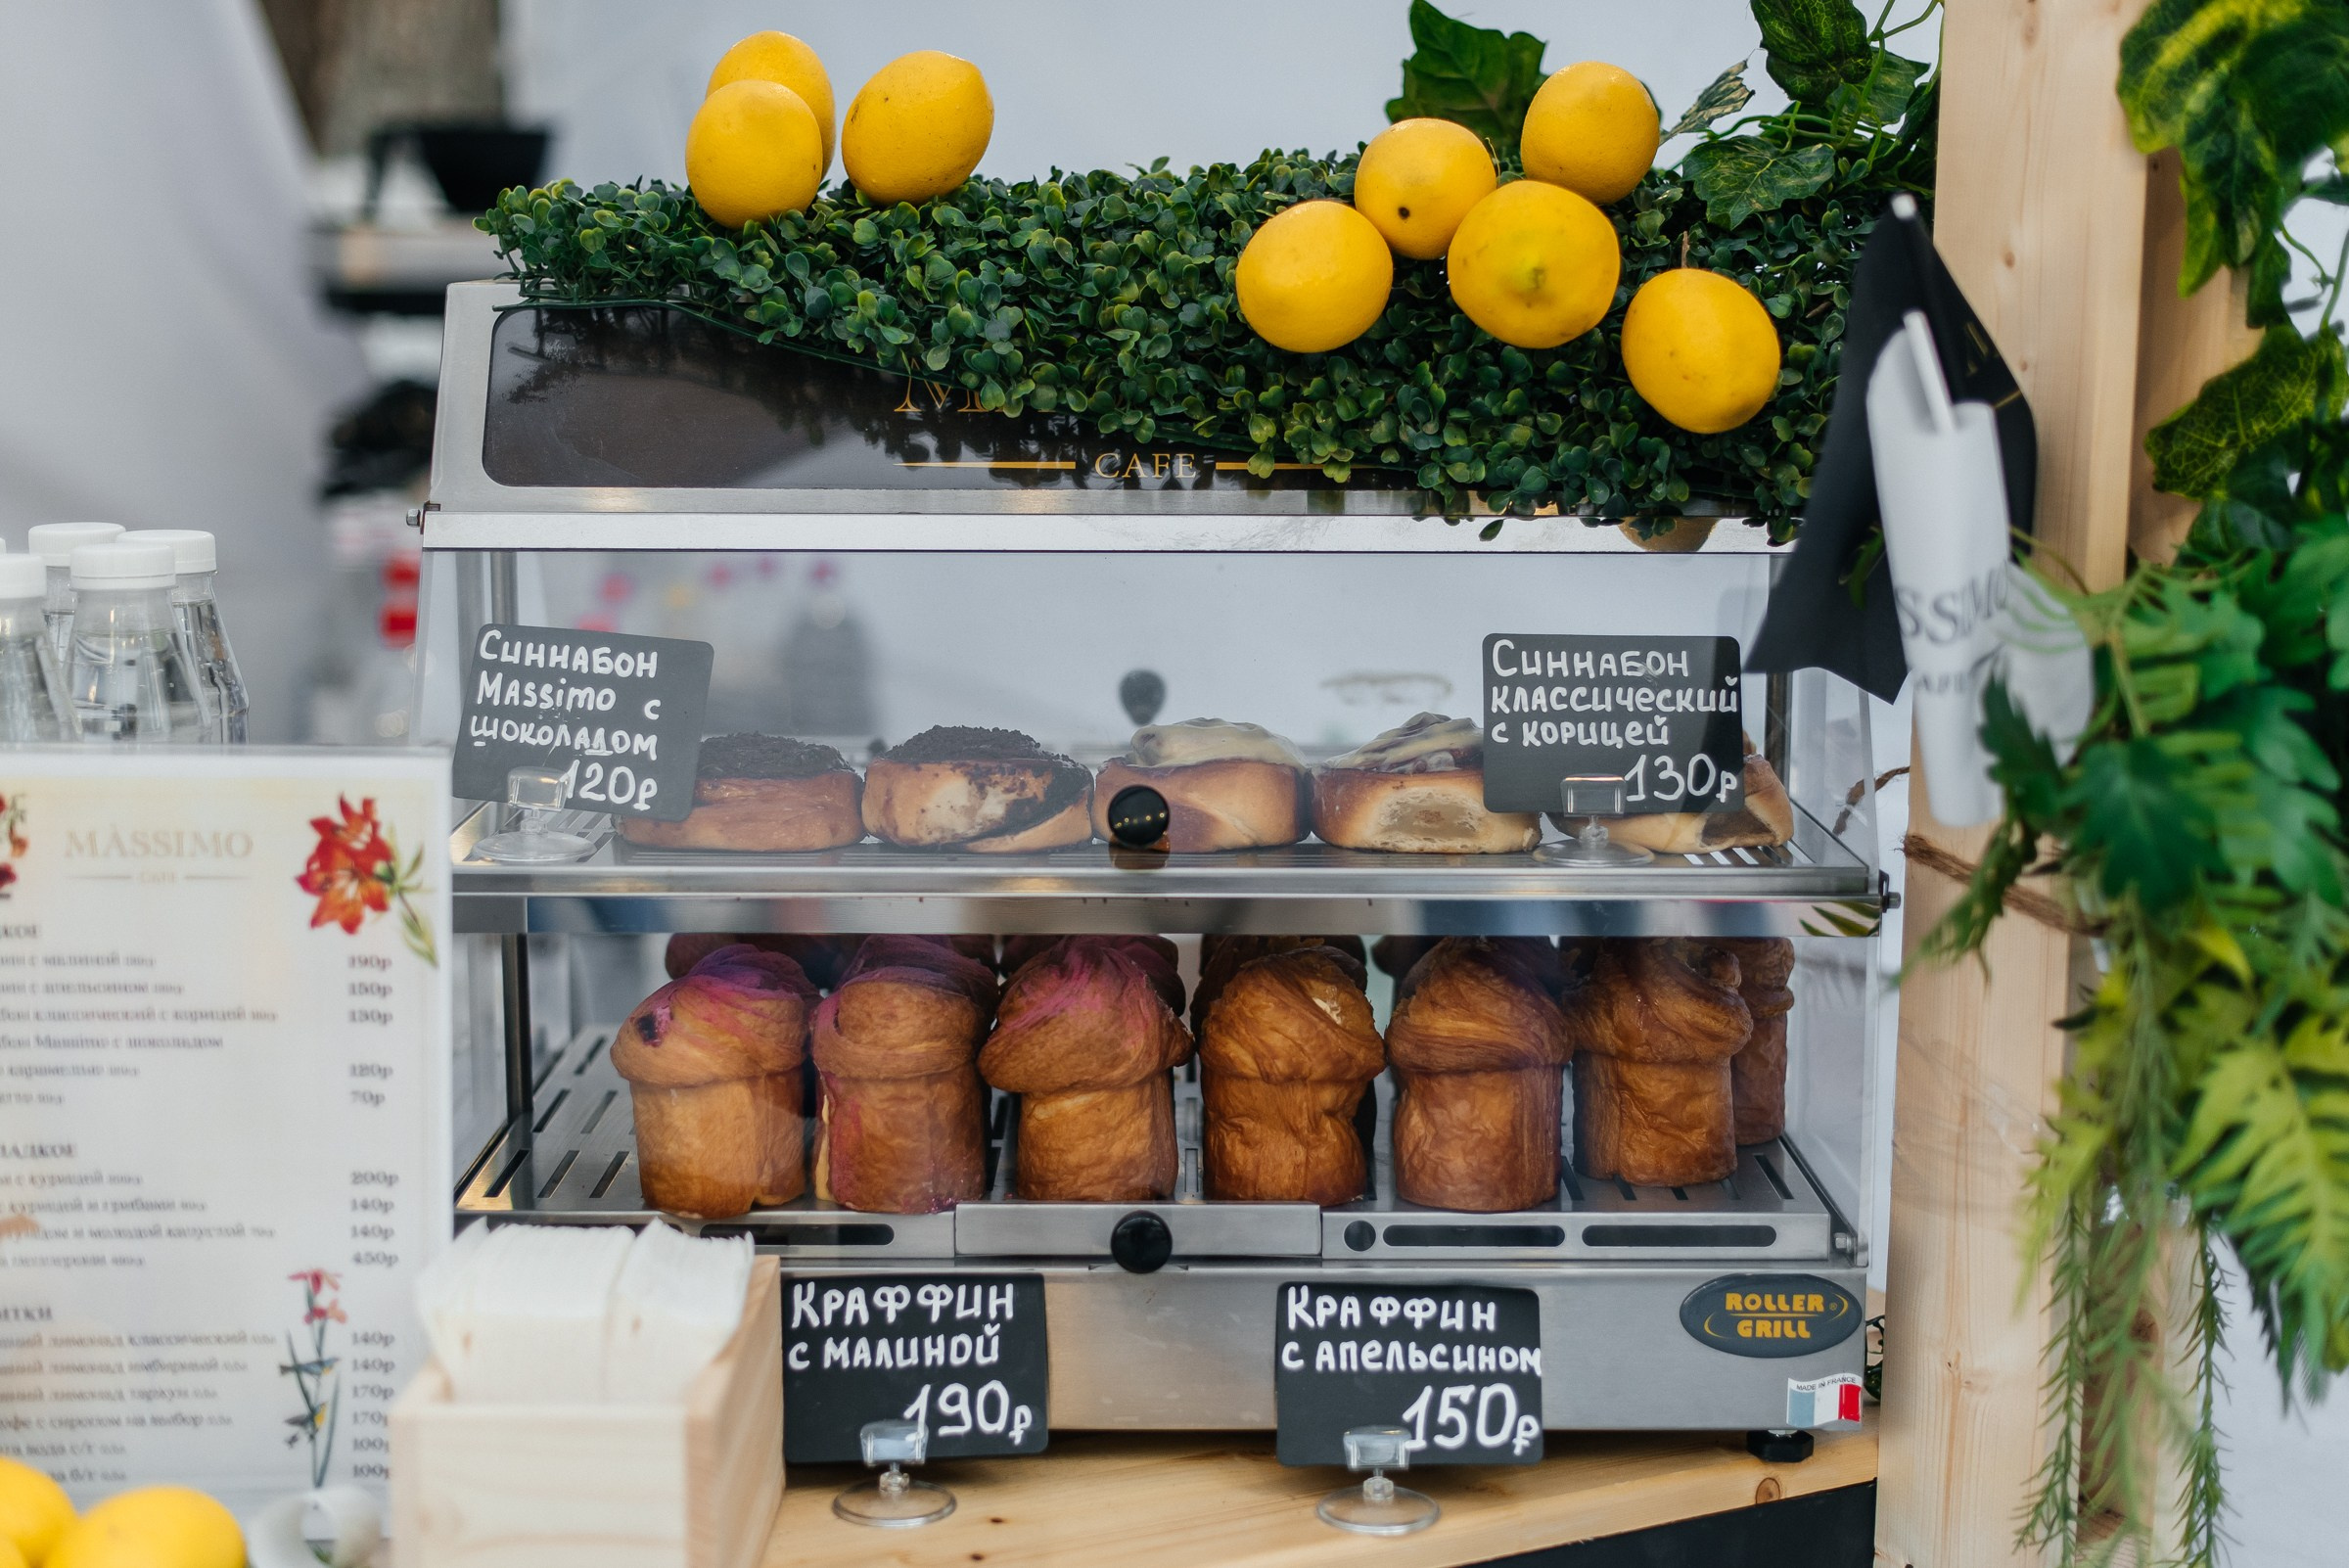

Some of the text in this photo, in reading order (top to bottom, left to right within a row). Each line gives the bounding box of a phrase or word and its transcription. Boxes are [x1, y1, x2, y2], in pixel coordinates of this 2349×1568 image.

[1094, 453, 1197, 480] CAFE
[1725, 1292, 1824, 1313] ROLLER
[1736, 1319, 1811, 1338] GRILL
[1826, 1376, 1856, 1385] FRANCE
